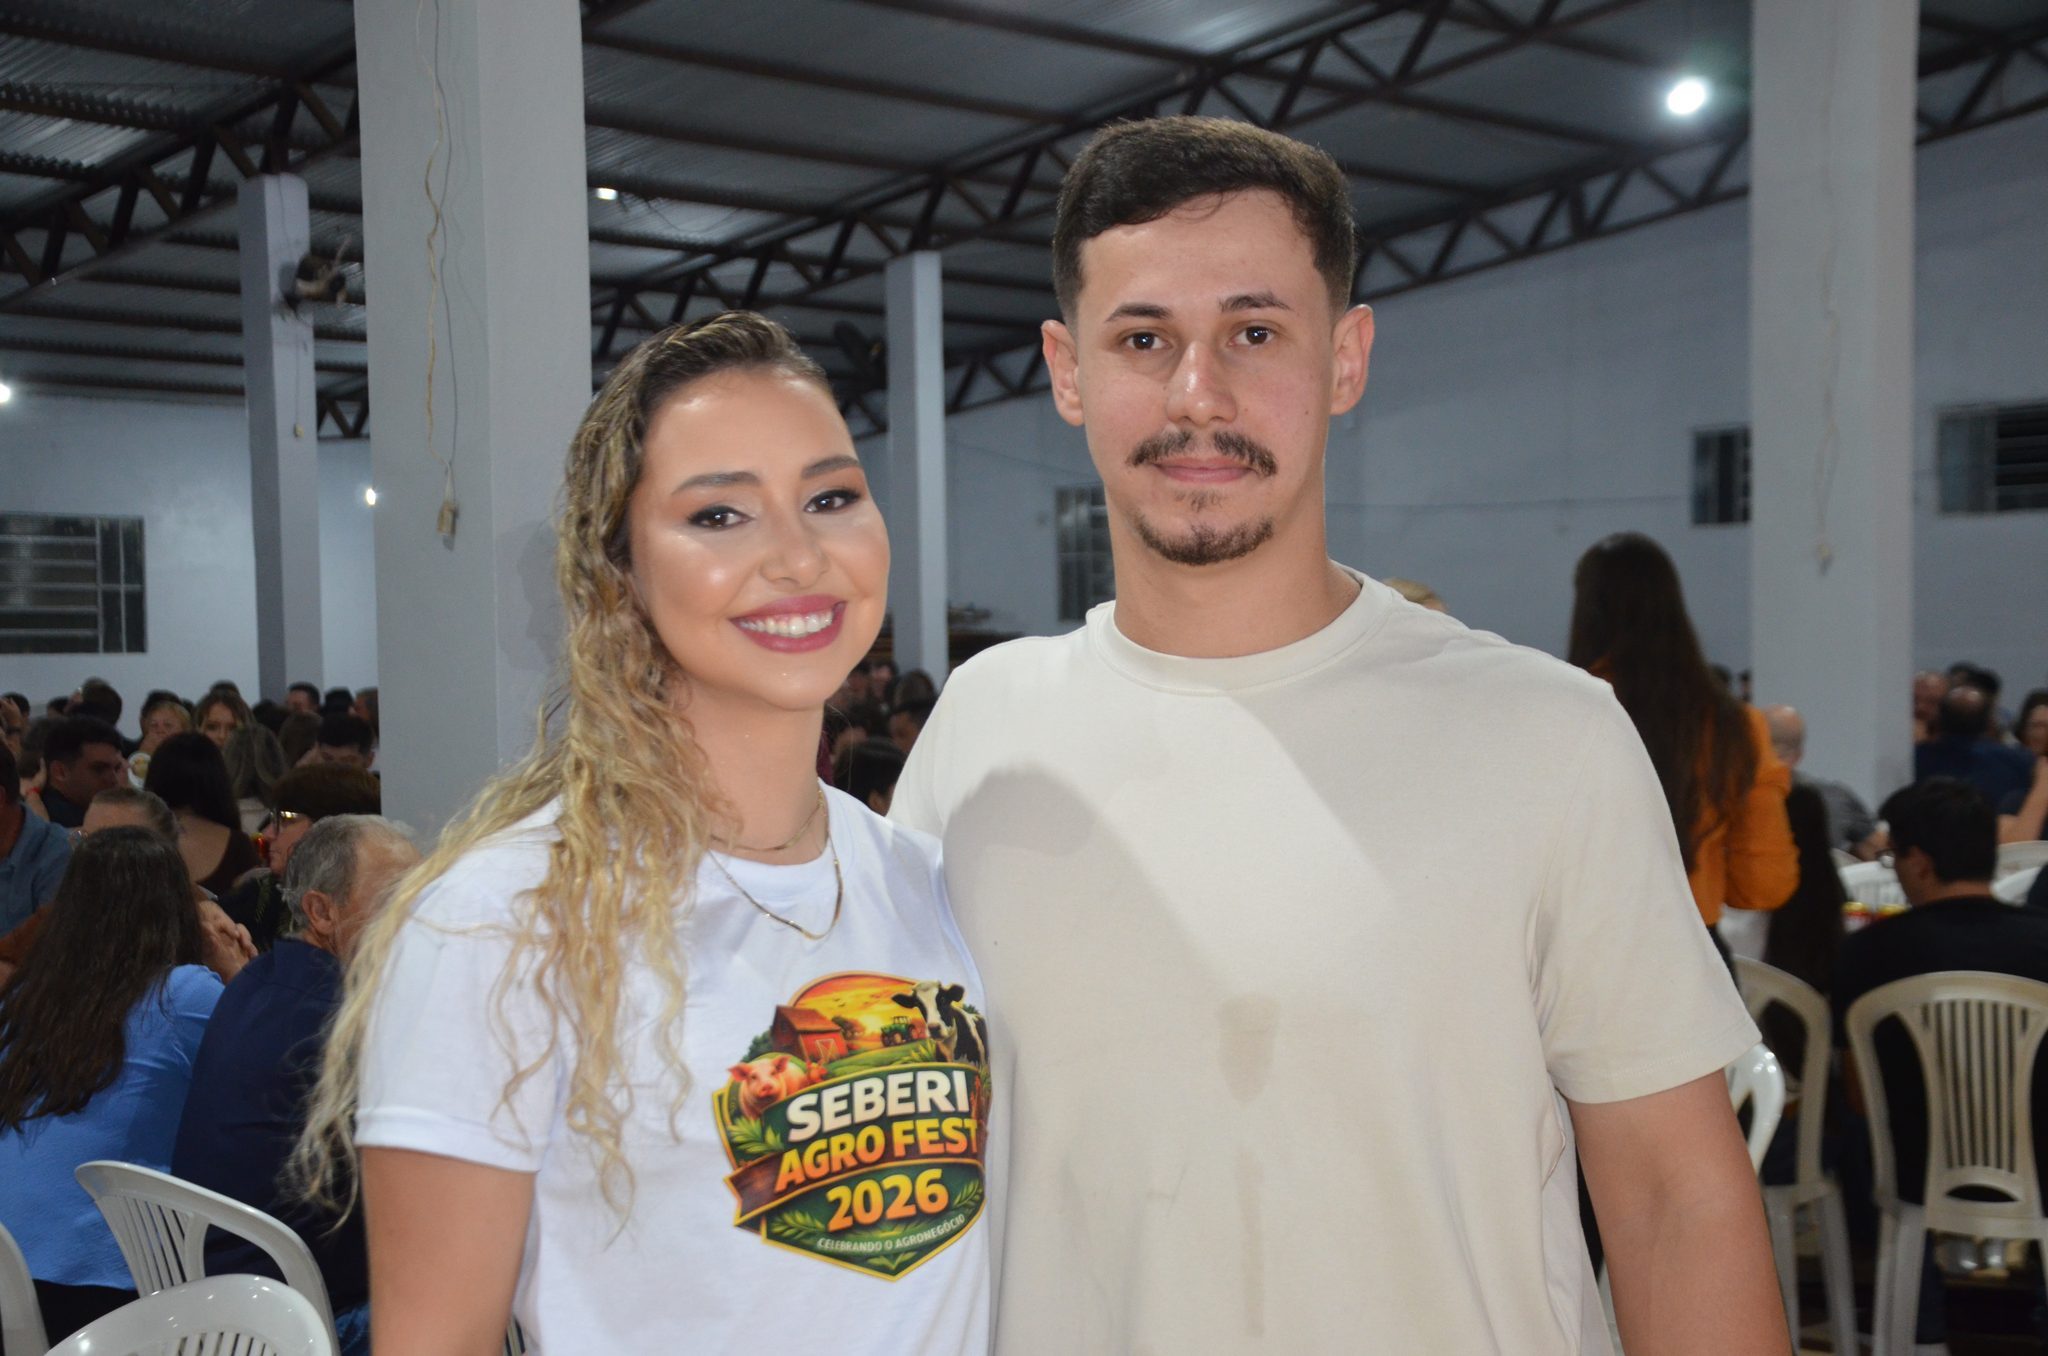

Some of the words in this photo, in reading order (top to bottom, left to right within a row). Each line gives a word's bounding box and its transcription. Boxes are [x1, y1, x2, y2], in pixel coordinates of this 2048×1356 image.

[786, 1070, 970, 1142] SEBERI
[774, 1125, 885, 1192] AGRO
[892, 1117, 978, 1157] FEST
[816, 1237, 882, 1252] CELEBRANDO
[885, 1240, 893, 1250] O
[895, 1214, 965, 1249] AGRONEGÓCIO
[826, 1168, 949, 1232] 2026
